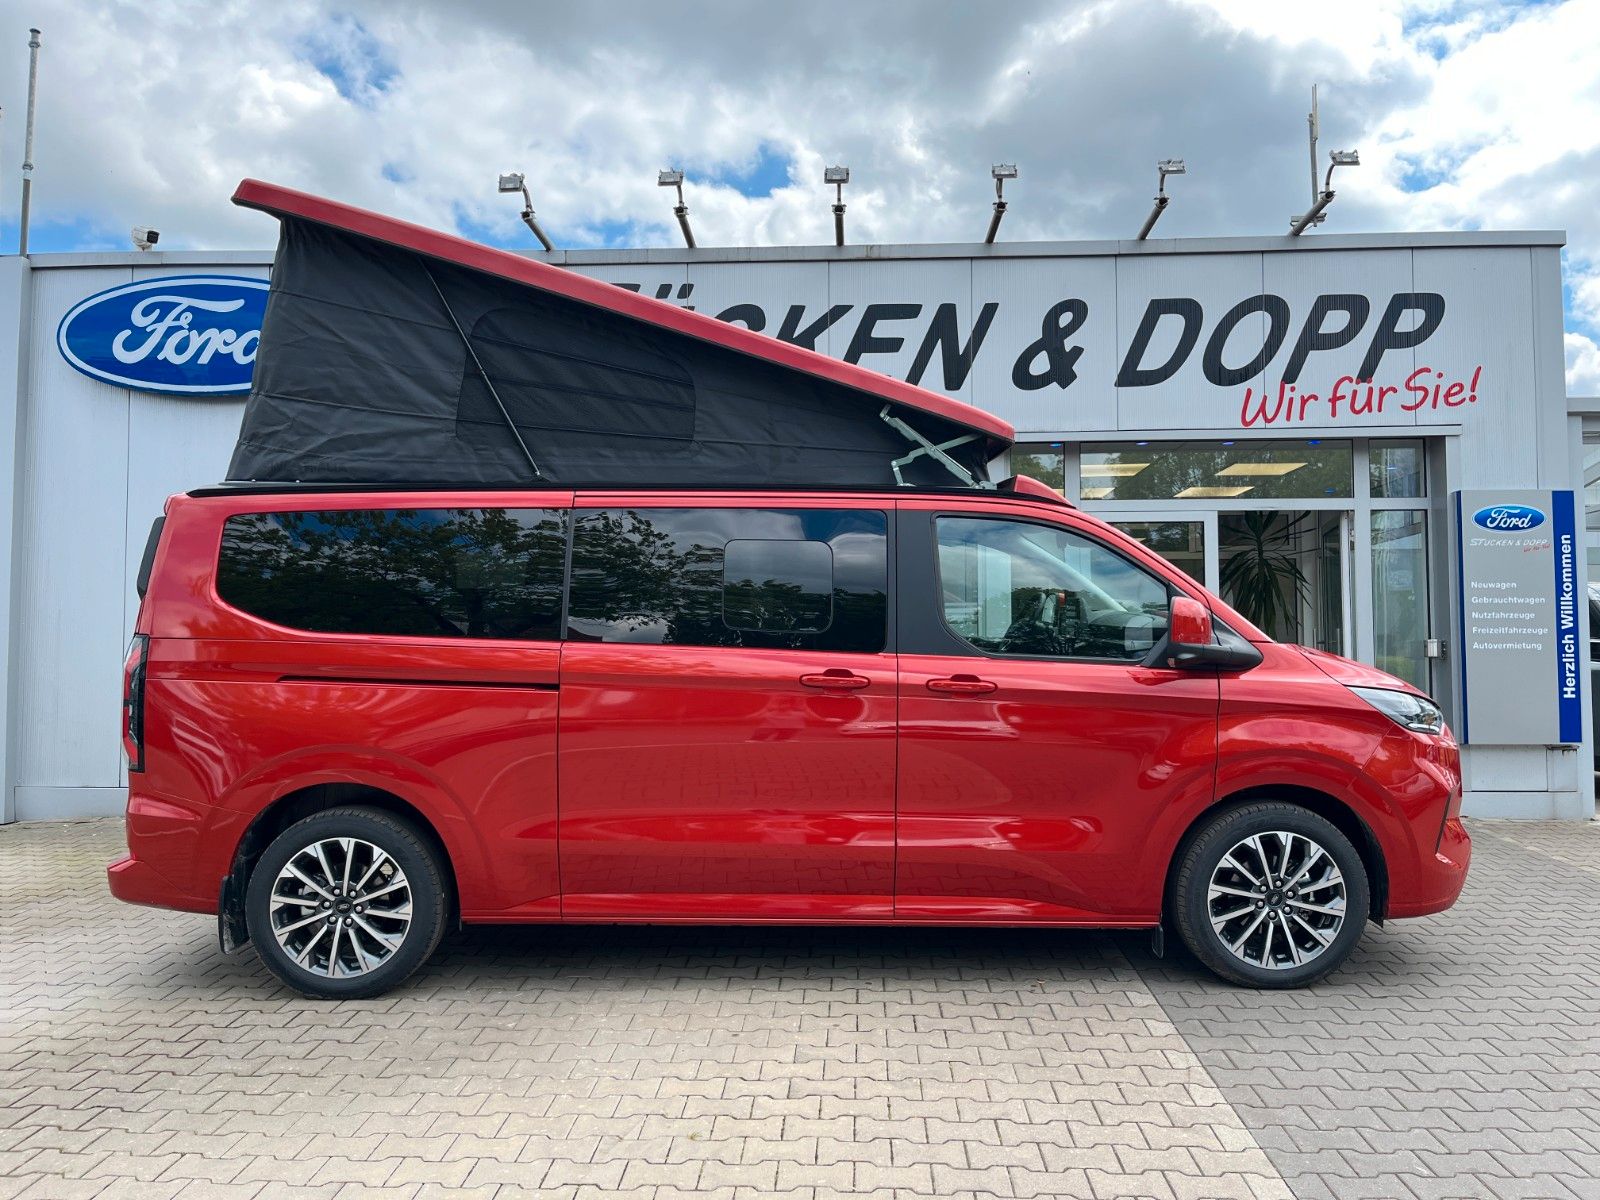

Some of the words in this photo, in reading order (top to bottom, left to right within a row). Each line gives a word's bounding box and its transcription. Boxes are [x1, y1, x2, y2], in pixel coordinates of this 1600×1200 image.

[1011, 298, 1089, 390] &
[1114, 292, 1446, 388] DOPP
[1241, 380, 1318, 427] Wir
[1328, 374, 1397, 418] für
[1400, 365, 1482, 412] Sie!
[1486, 508, 1532, 528] Ford
[1471, 581, 1517, 589] Neuwagen
[1560, 534, 1574, 630] Willkommen
[1471, 596, 1546, 605] Gebrauchtwagen
[1471, 611, 1536, 620] Nutzfahrzeuge
[1472, 626, 1549, 635] Freizeitfahrzeuge
[1472, 641, 1542, 651] Autovermietung
[1562, 634, 1576, 698] Herzlich
